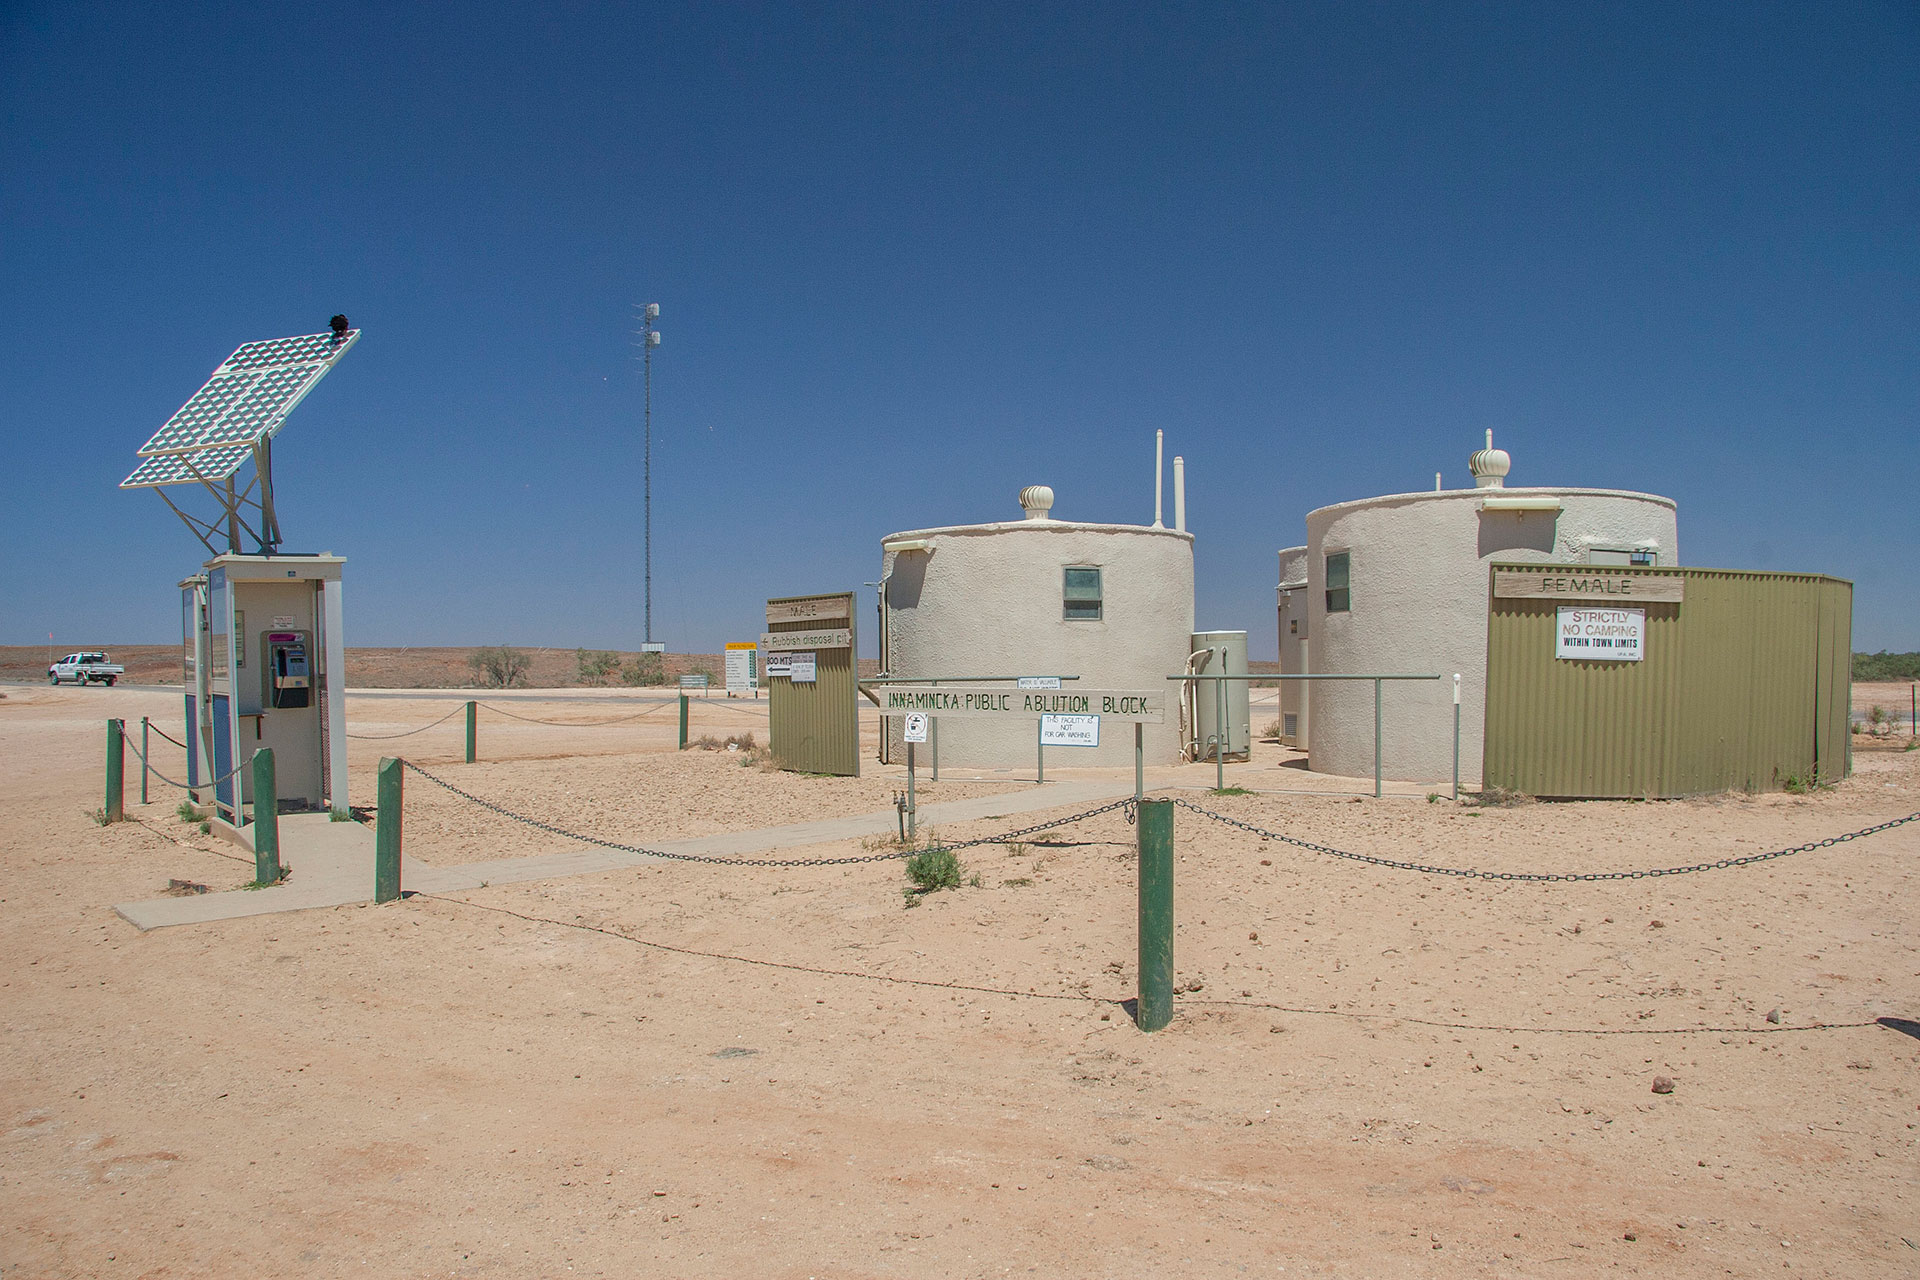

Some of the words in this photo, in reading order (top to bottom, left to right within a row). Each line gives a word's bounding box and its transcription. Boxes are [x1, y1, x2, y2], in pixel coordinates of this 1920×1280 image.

[1541, 578, 1632, 595] FEMALE
[790, 604, 817, 617] MALE
[1573, 611, 1630, 623] STRICTLY
[1562, 624, 1581, 636] NO
[1585, 624, 1638, 637] CAMPING
[772, 635, 801, 647] Rubbish
[803, 632, 834, 647] disposal
[836, 631, 849, 645] pit
[1563, 637, 1590, 647] WITHIN
[1592, 638, 1613, 648] TOWN
[1614, 639, 1638, 649] LIMITS
[779, 656, 792, 665] MTS
[888, 692, 960, 710] INNAMINCKA
[965, 694, 1010, 711] PUBLIC
[1023, 694, 1089, 713] ABLUTION
[1046, 716, 1059, 724] THIS
[1067, 731, 1091, 739] WASHING
